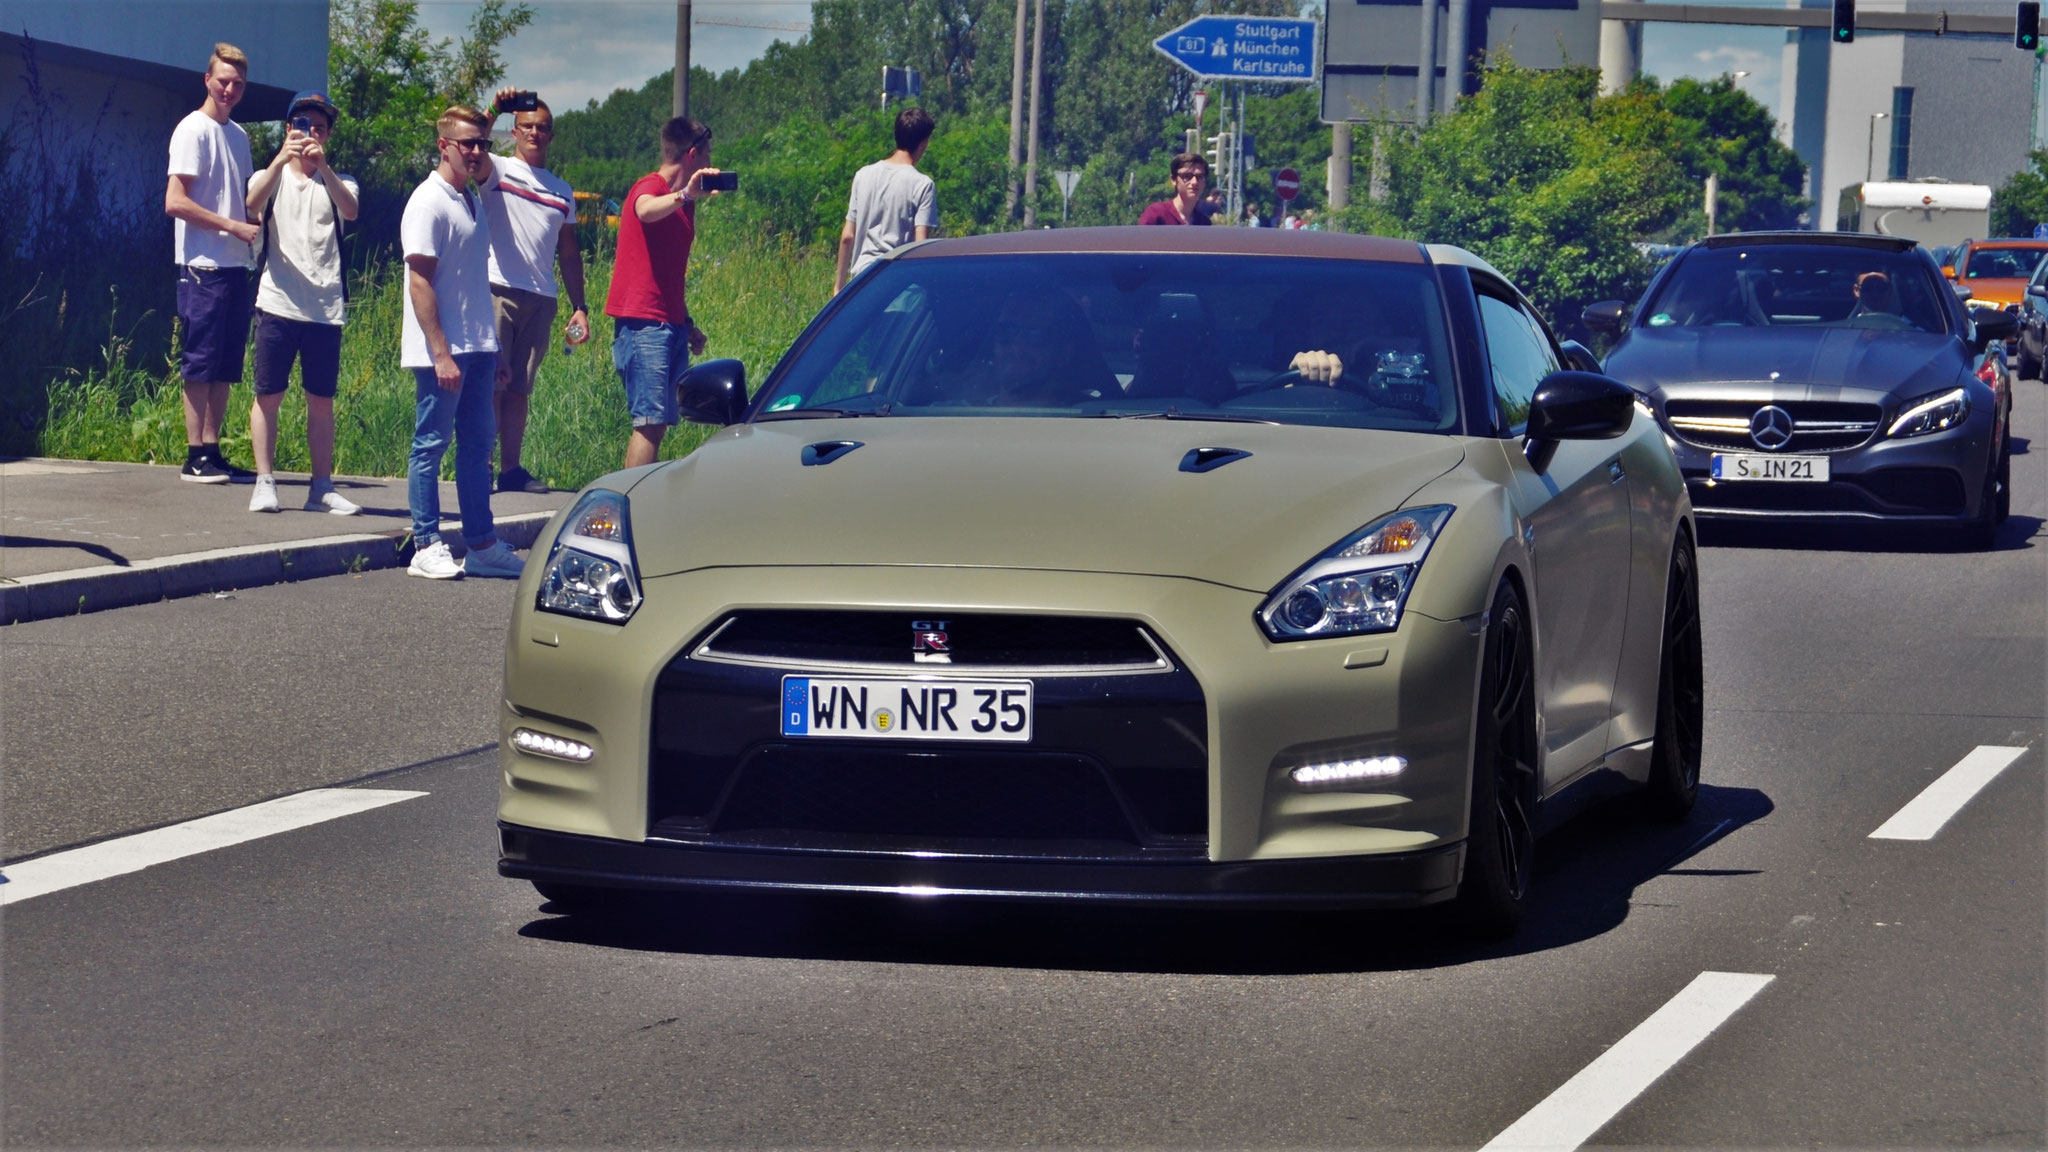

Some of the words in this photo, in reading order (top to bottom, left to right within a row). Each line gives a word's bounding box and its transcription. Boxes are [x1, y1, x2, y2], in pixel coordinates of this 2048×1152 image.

[1235, 23, 1300, 40] Stuttgart
[1233, 40, 1300, 55] München
[1233, 58, 1305, 73] Karlsruhe
[1738, 459, 1749, 477] S
[1763, 460, 1786, 478] IN
[1790, 461, 1814, 479] 21
[811, 685, 868, 730] WN
[900, 687, 959, 731] NR
[970, 689, 1026, 733] 35
[791, 713, 800, 725] D
